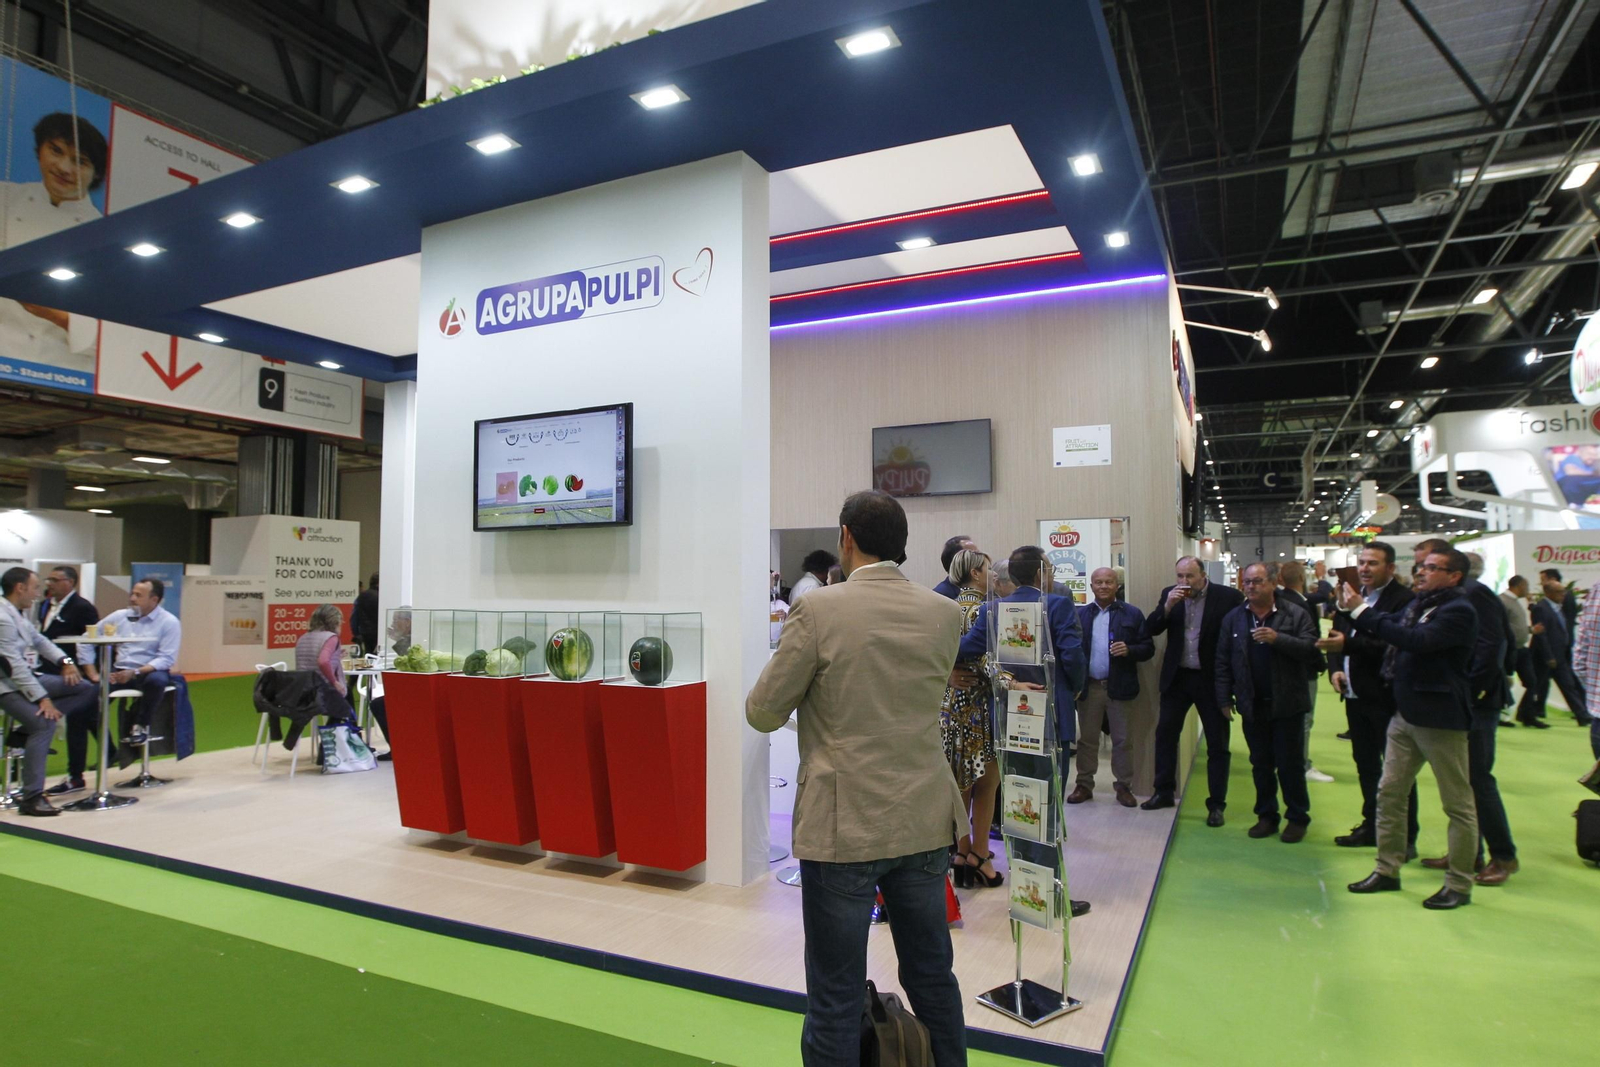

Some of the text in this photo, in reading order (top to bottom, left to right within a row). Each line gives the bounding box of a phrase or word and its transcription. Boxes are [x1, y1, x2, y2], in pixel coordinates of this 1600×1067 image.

[144, 134, 222, 173] ACCESS TO HALL
[20, 367, 53, 381] Stand
[264, 378, 279, 399] 9
[1263, 472, 1277, 487] C
[307, 526, 322, 534] fruit
[307, 534, 343, 543] attraction
[1050, 533, 1078, 545] PULPY
[275, 556, 334, 567] THANK YOU
[1049, 549, 1087, 564] ISBÄR
[275, 569, 344, 580] FOR COMING
[275, 587, 356, 602] See you next year!
[273, 633, 297, 645] 2020
